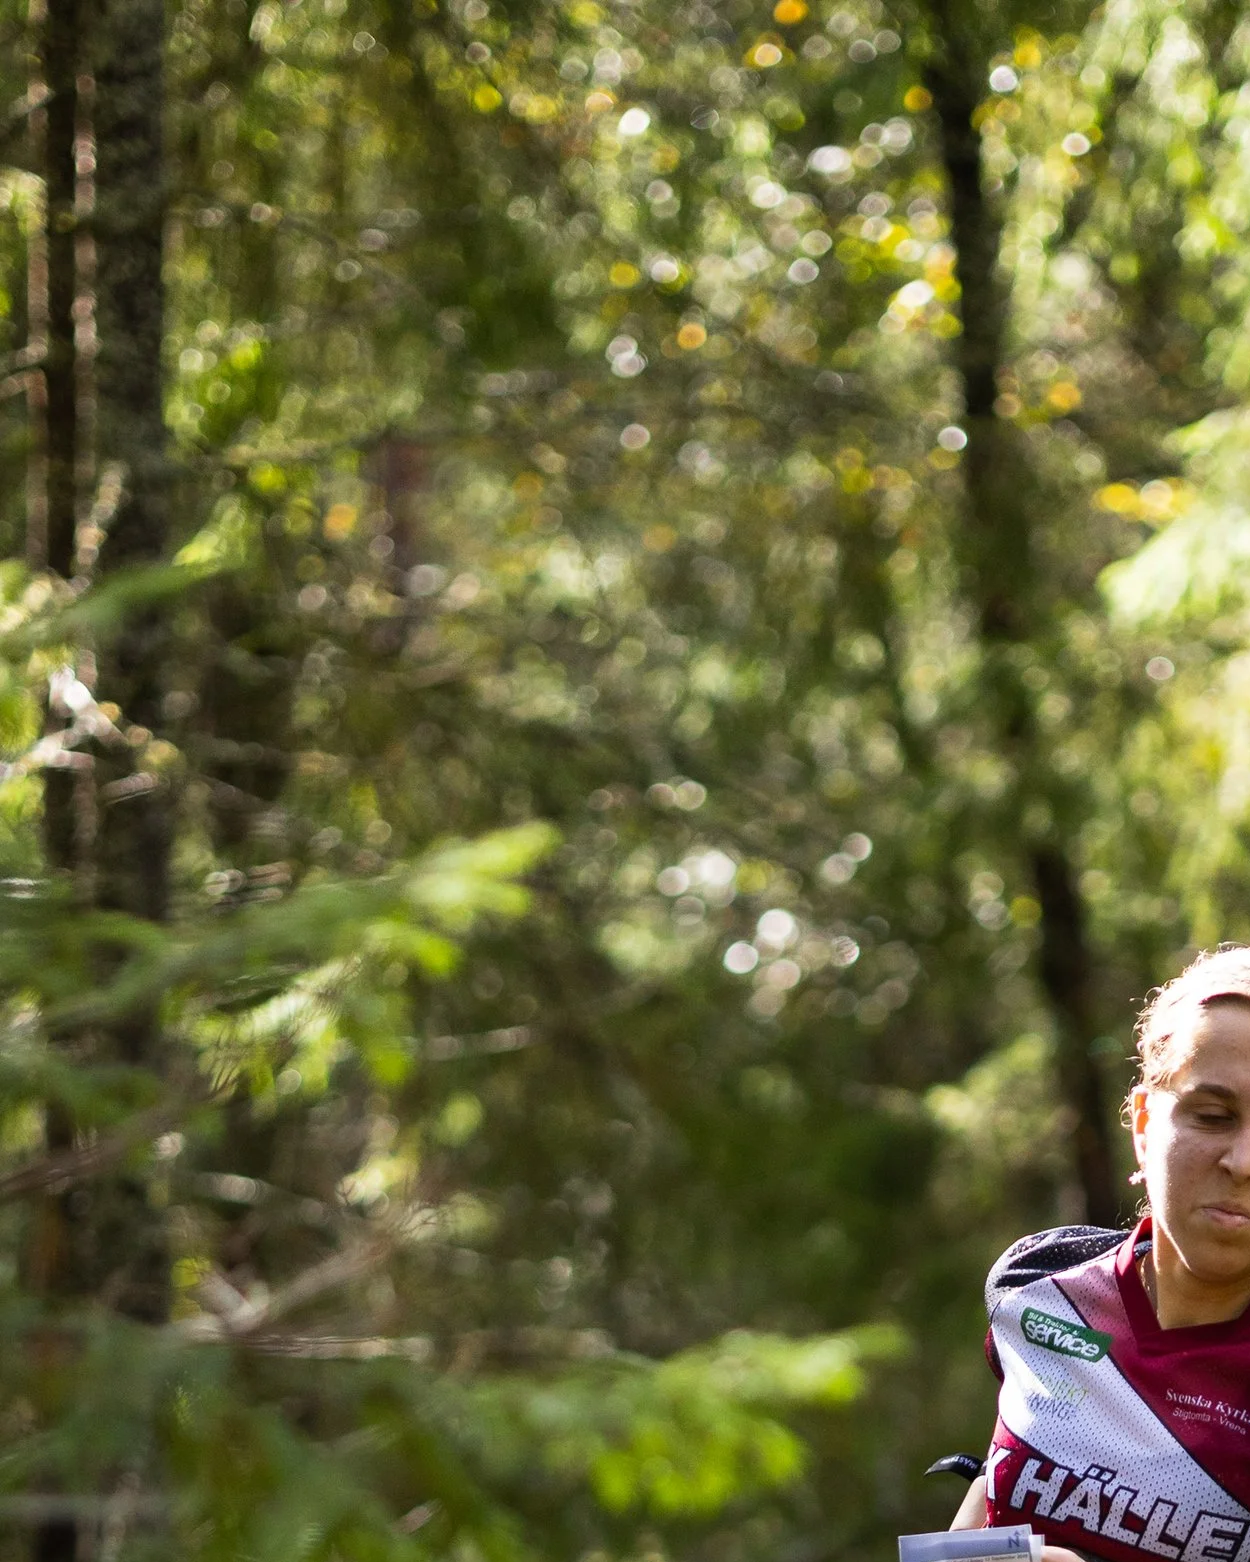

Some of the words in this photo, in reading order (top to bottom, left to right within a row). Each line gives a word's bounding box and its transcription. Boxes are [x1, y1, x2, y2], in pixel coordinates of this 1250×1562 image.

[1166, 1387, 1212, 1409] Svenska
[1172, 1407, 1211, 1423] Stigtomta
[1219, 1415, 1246, 1435] Vrena
